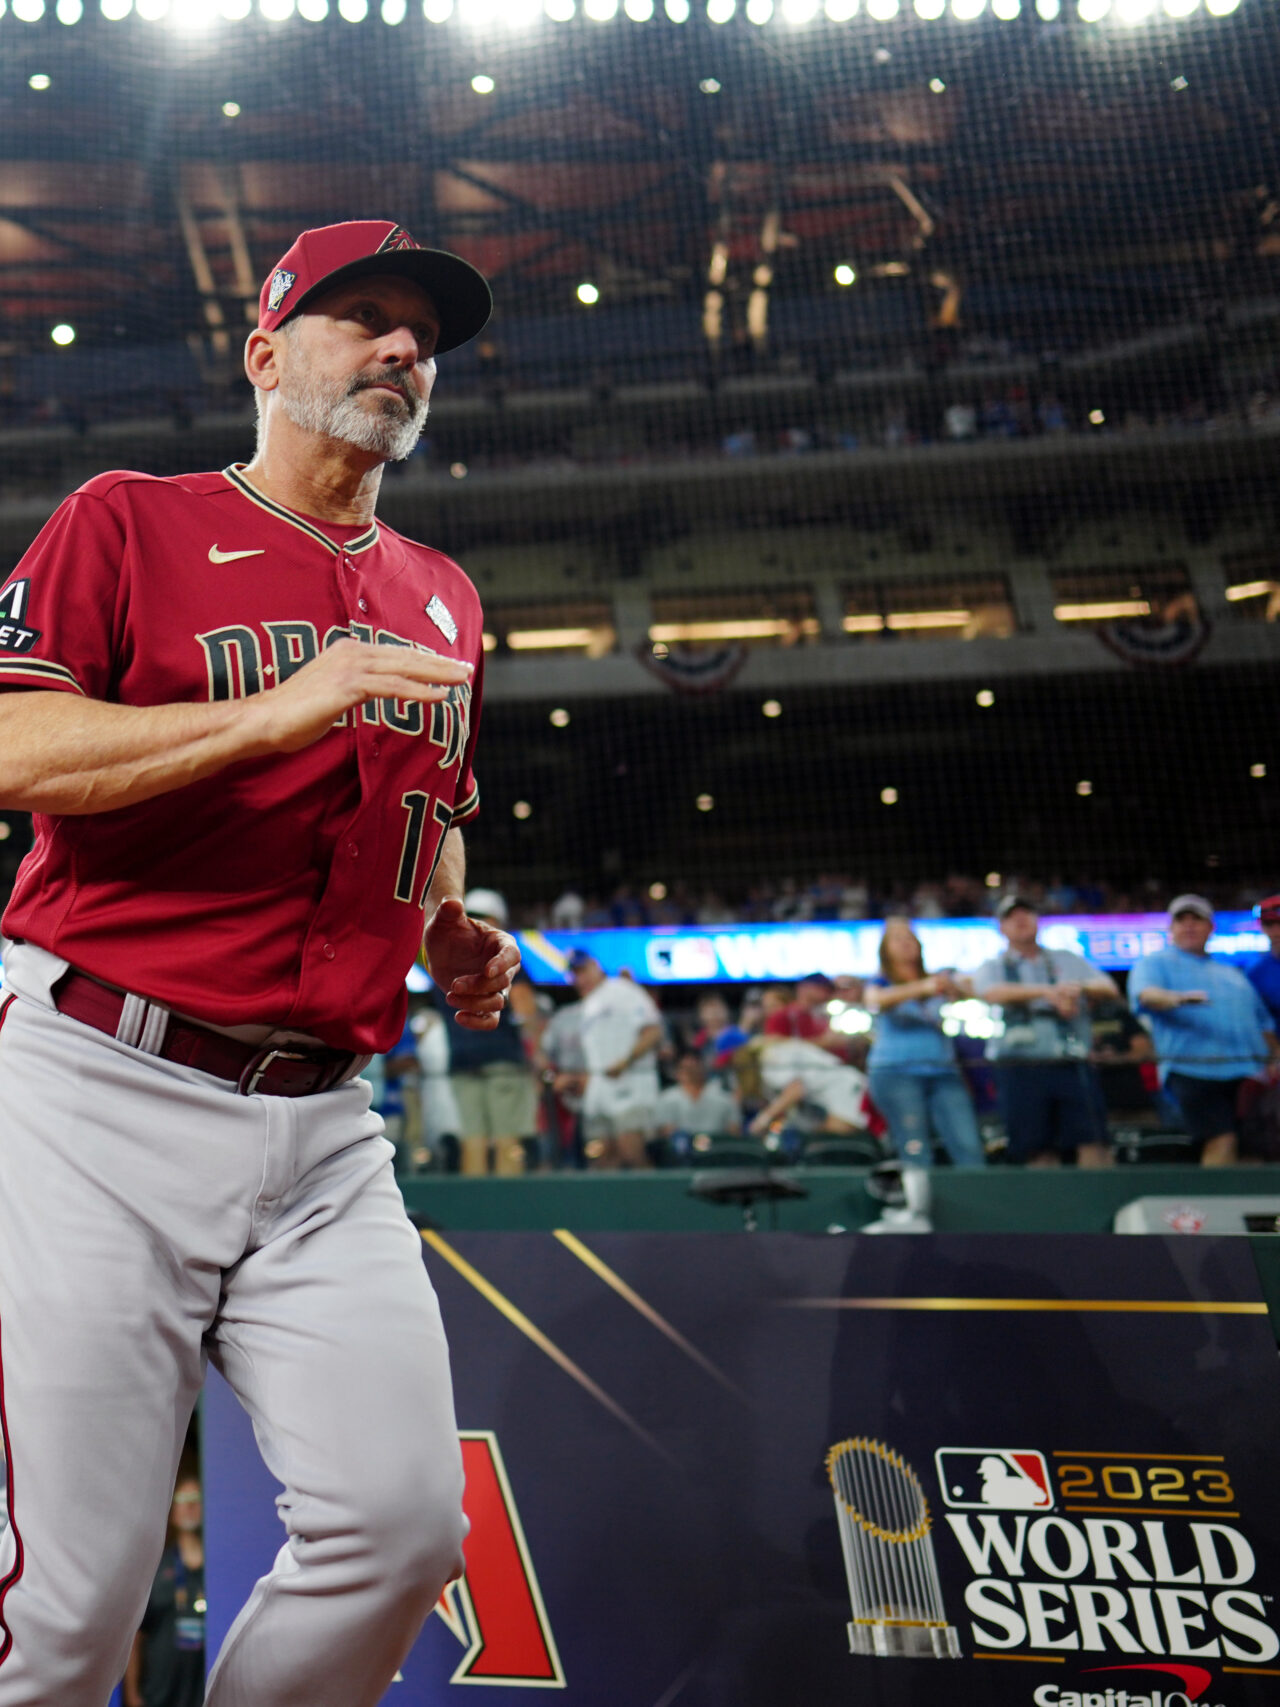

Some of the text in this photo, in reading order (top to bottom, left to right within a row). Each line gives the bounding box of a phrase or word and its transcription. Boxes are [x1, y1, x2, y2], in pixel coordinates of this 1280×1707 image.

[394, 789, 454, 910] 17
[1057, 1465, 1235, 1503] 2023
[944, 1513, 1257, 1586] WORLD
[964, 1578, 1280, 1663] SERIES
